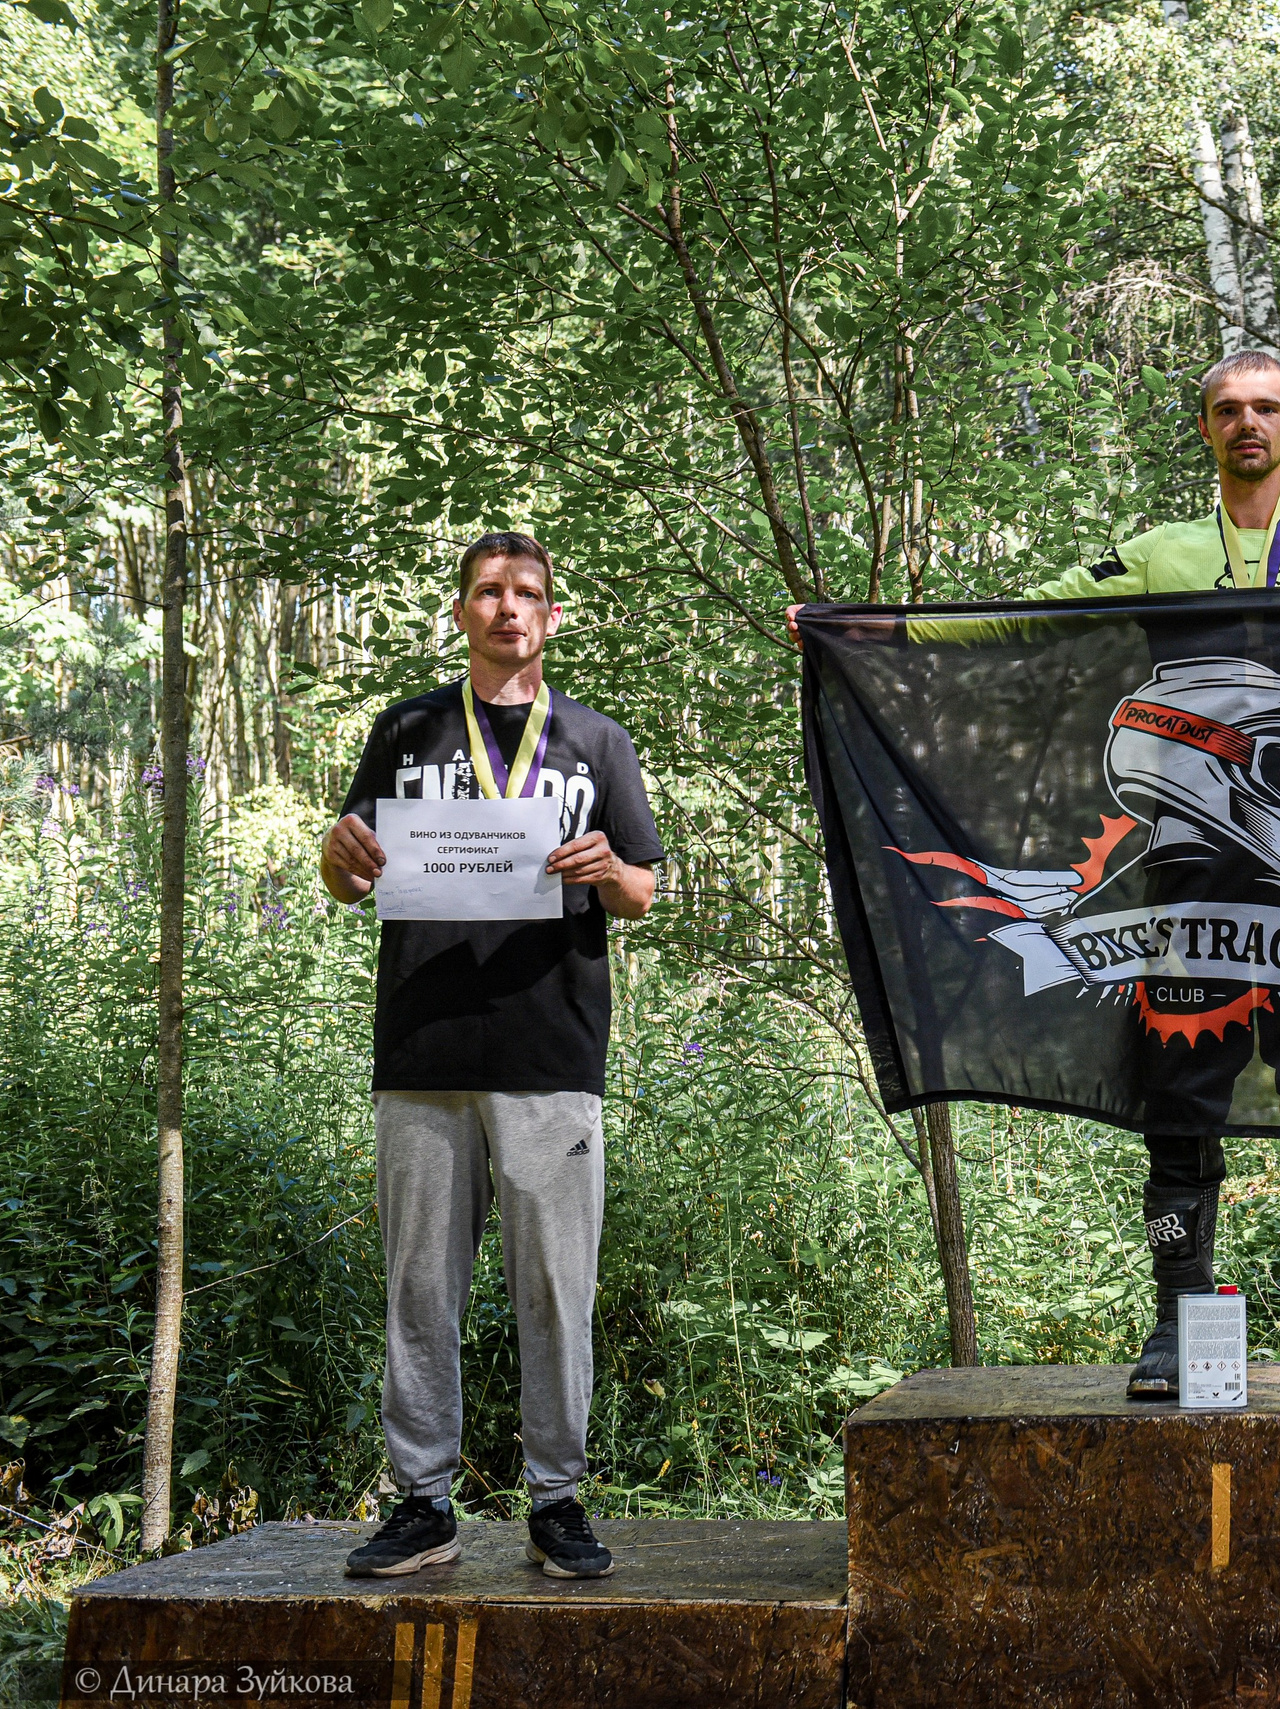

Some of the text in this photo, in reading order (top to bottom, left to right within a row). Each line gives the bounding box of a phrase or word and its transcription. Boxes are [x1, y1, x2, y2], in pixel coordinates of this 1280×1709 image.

[1125, 707, 1221, 744] PROCAT DUST
[410, 830, 526, 841] ВИНО ИЗ ОДУВАНЧИКОВ
[436, 846, 500, 855] СЕРТИФИКАТ
[423, 860, 514, 874] 1000 РУБЛЕЙ
[1069, 916, 1175, 971] BIKE'S
[1156, 986, 1205, 1003] CLUB
